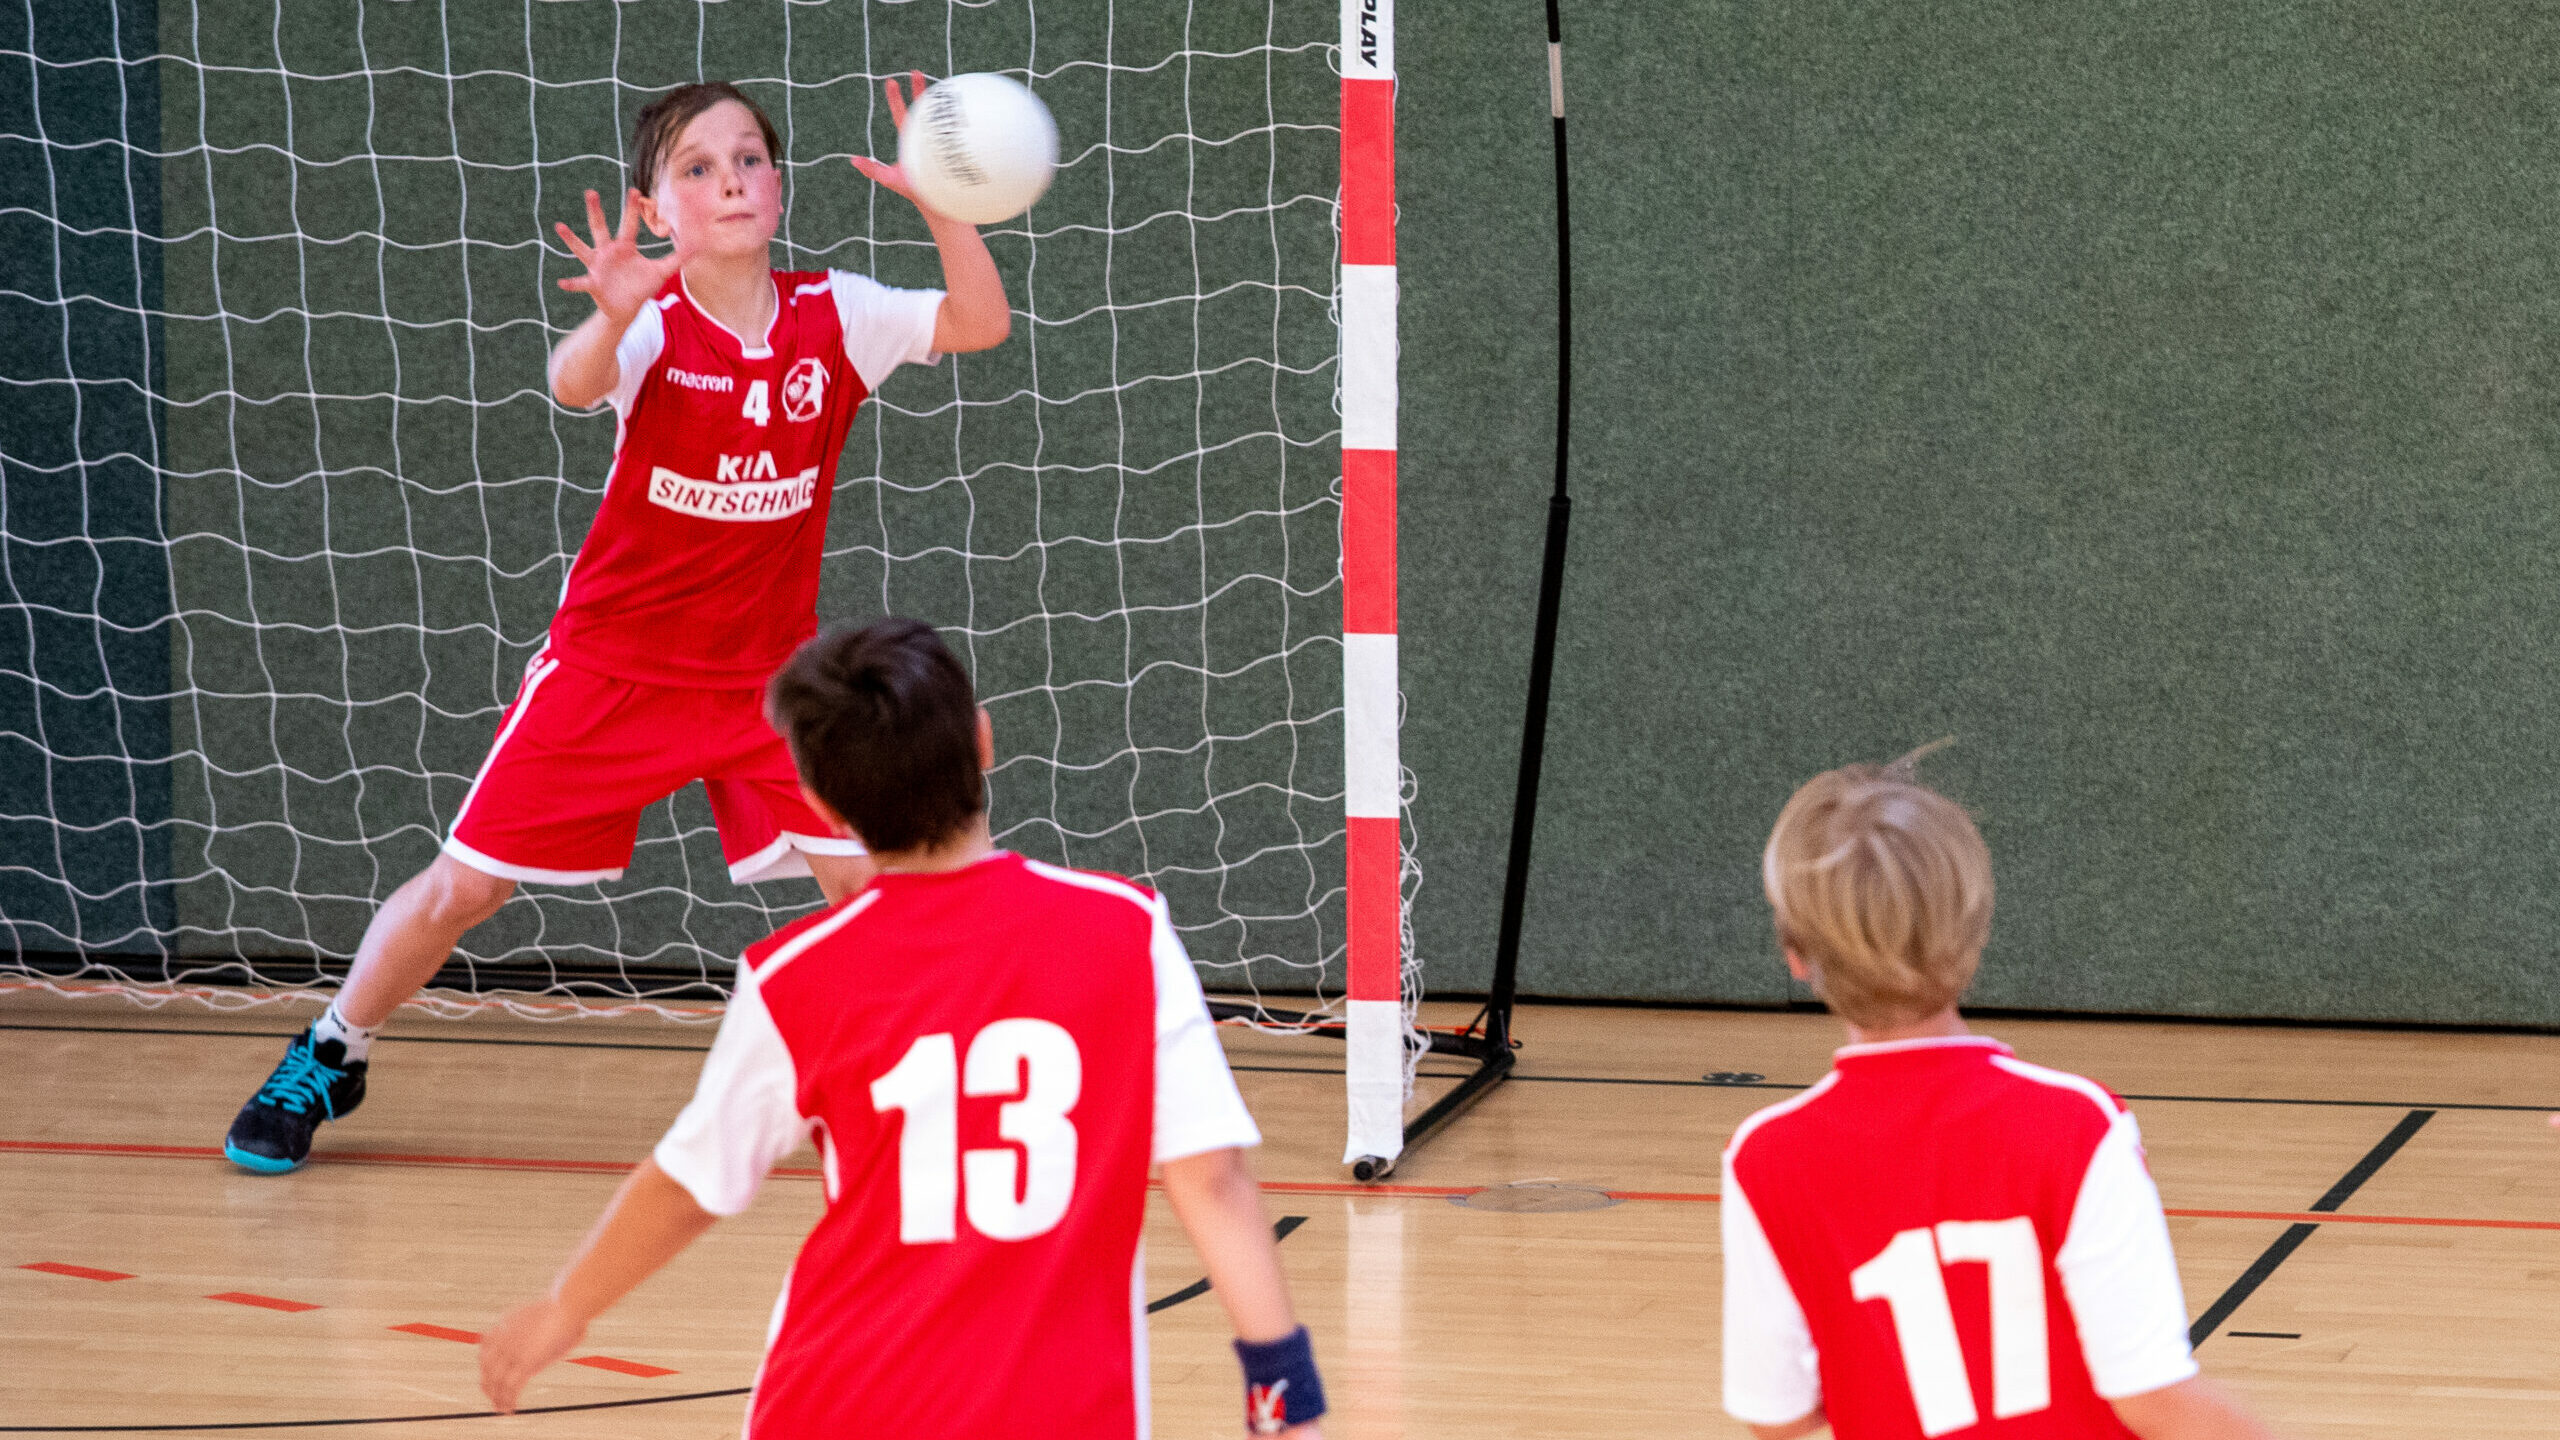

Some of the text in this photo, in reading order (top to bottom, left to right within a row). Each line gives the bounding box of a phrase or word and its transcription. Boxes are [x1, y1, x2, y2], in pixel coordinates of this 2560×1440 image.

[666, 366, 734, 393] macron
[742, 379, 771, 427] 4
[716, 450, 778, 482] KIA
[656, 477, 817, 514] SINTSCHNIG
[869, 1017, 1083, 1245] 13
[1849, 1214, 2051, 1438] 17
